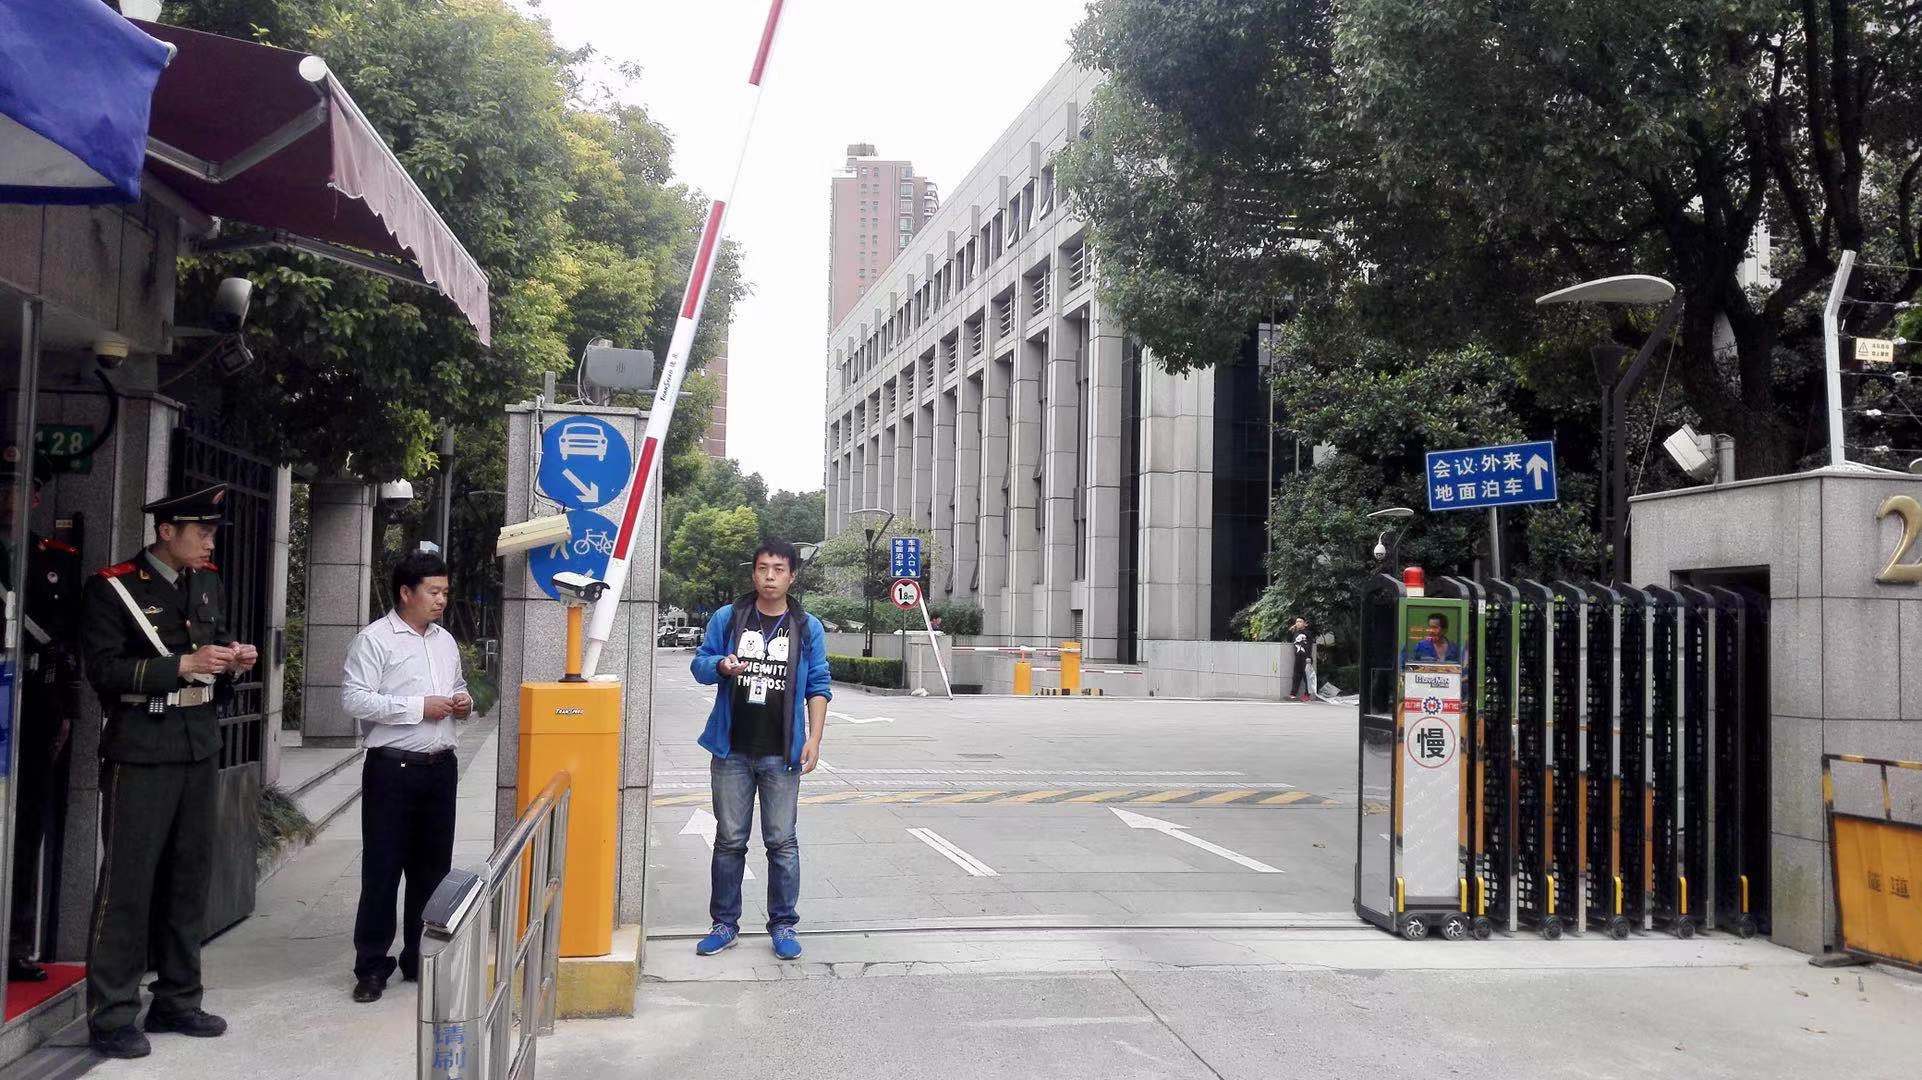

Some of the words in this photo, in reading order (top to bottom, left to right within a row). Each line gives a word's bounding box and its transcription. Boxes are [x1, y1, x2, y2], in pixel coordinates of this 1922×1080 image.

[1434, 477, 1524, 502] 地面泊车
[1417, 727, 1446, 759] 慢
[433, 1024, 466, 1080] 请刷
